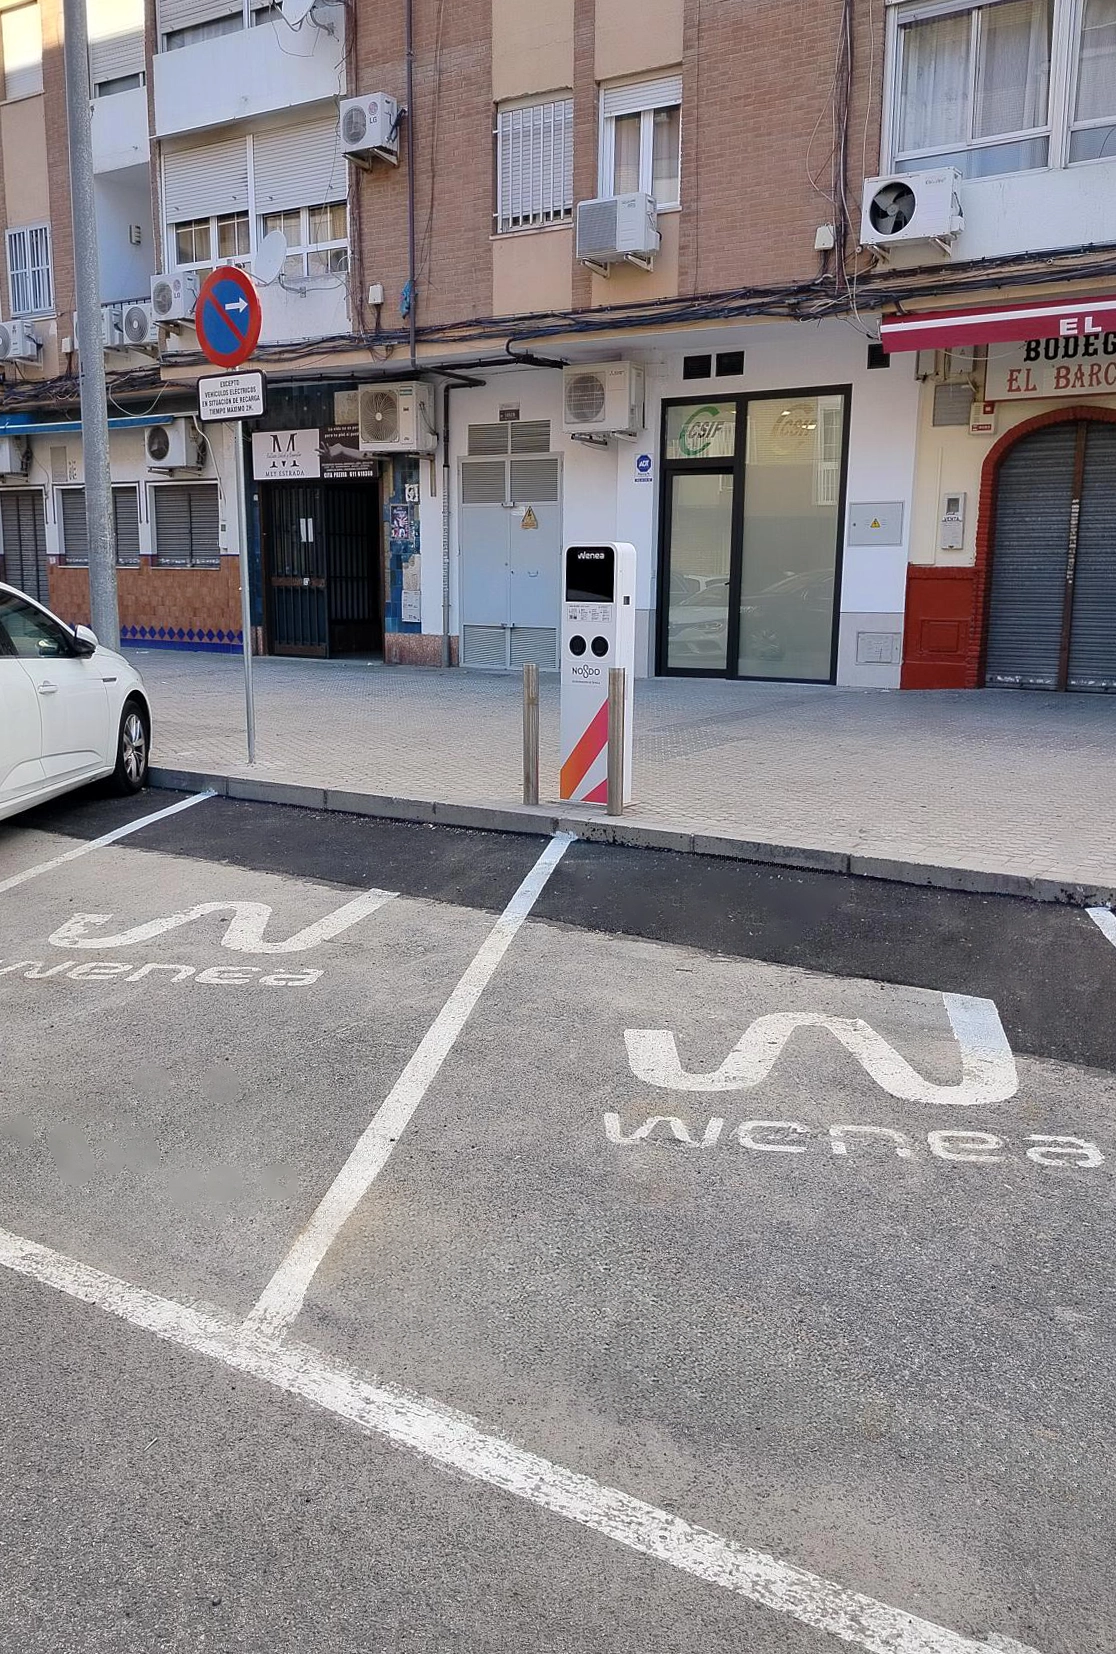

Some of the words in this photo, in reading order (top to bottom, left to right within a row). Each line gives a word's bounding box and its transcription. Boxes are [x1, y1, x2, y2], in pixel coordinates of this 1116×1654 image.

[369, 116, 377, 124] LG
[1060, 316, 1102, 336] EL
[220, 379, 240, 388] EXCEPTO
[1007, 368, 1037, 393] EL
[202, 400, 208, 408] EN
[239, 394, 261, 404] RECARGA
[209, 407, 226, 416] TIEMPO
[688, 421, 725, 439] CSIF
[639, 460, 650, 468] ADT
[279, 469, 305, 477] ESTRADA
